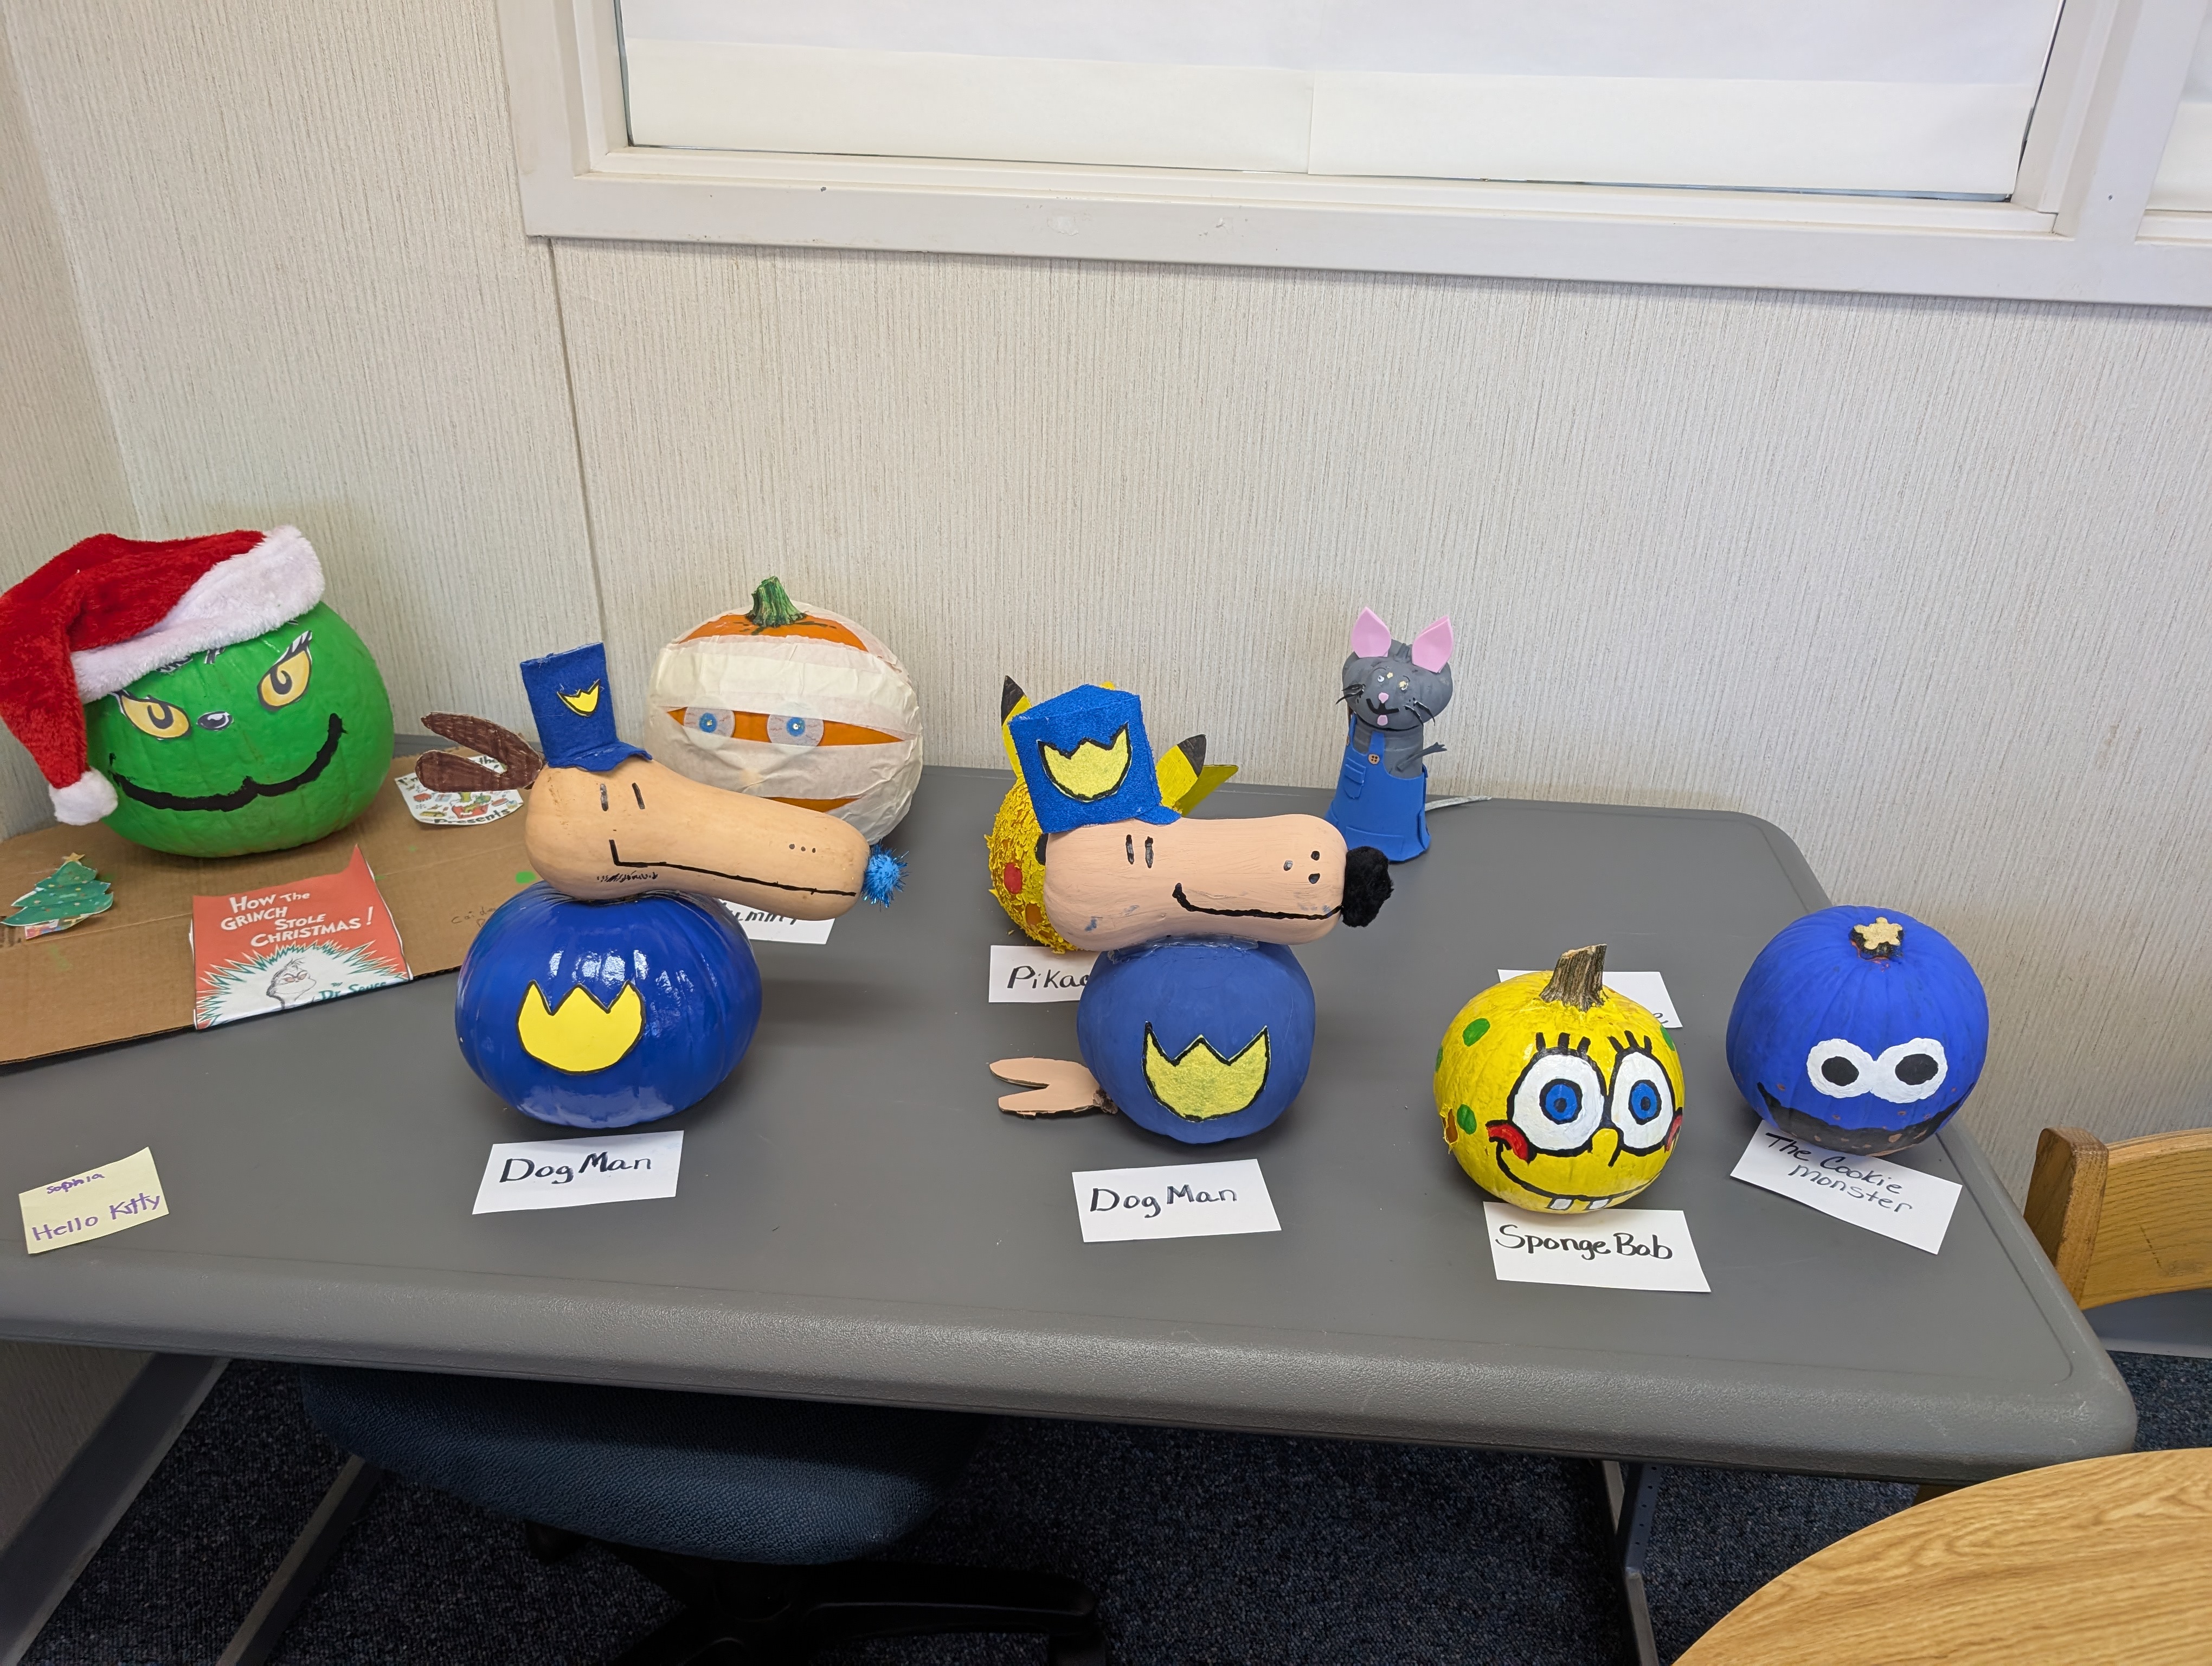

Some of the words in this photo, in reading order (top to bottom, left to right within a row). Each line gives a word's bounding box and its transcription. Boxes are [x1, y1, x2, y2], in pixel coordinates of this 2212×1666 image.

[280, 893, 310, 902] The
[221, 906, 288, 931] GRINCH
[275, 914, 326, 930] STOLE
[1765, 1132, 1812, 1162] The
[32, 1217, 98, 1241] Hello
[109, 1193, 160, 1220] Kitty
